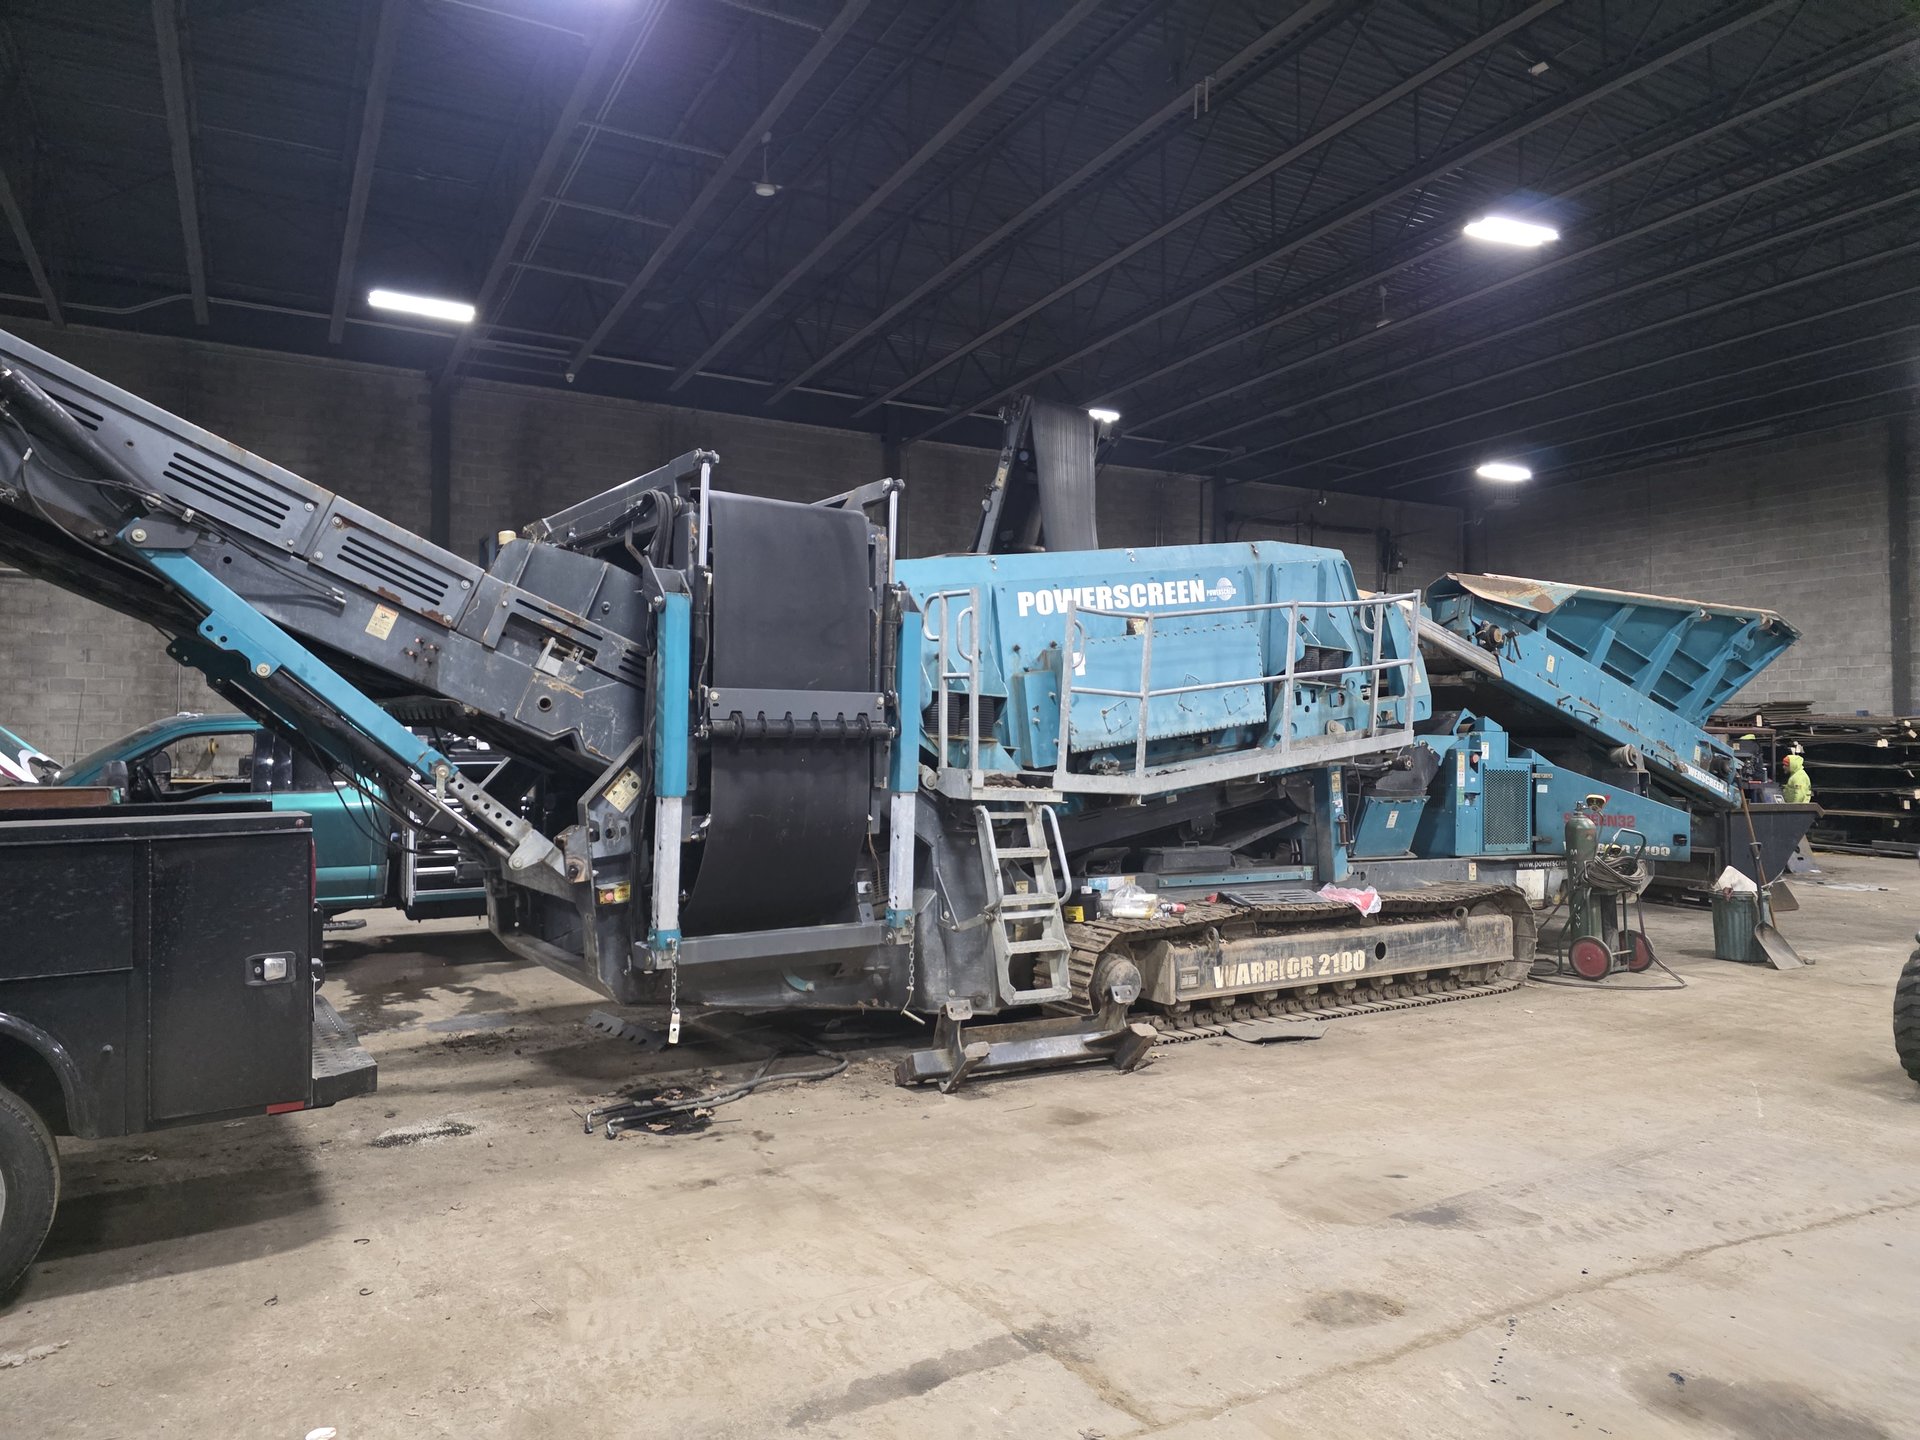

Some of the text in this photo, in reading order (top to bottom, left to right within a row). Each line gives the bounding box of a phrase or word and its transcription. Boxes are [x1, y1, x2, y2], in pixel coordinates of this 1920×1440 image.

[1017, 579, 1206, 617] POWERSCREEN
[1213, 949, 1366, 989] WARRIOR 2100
